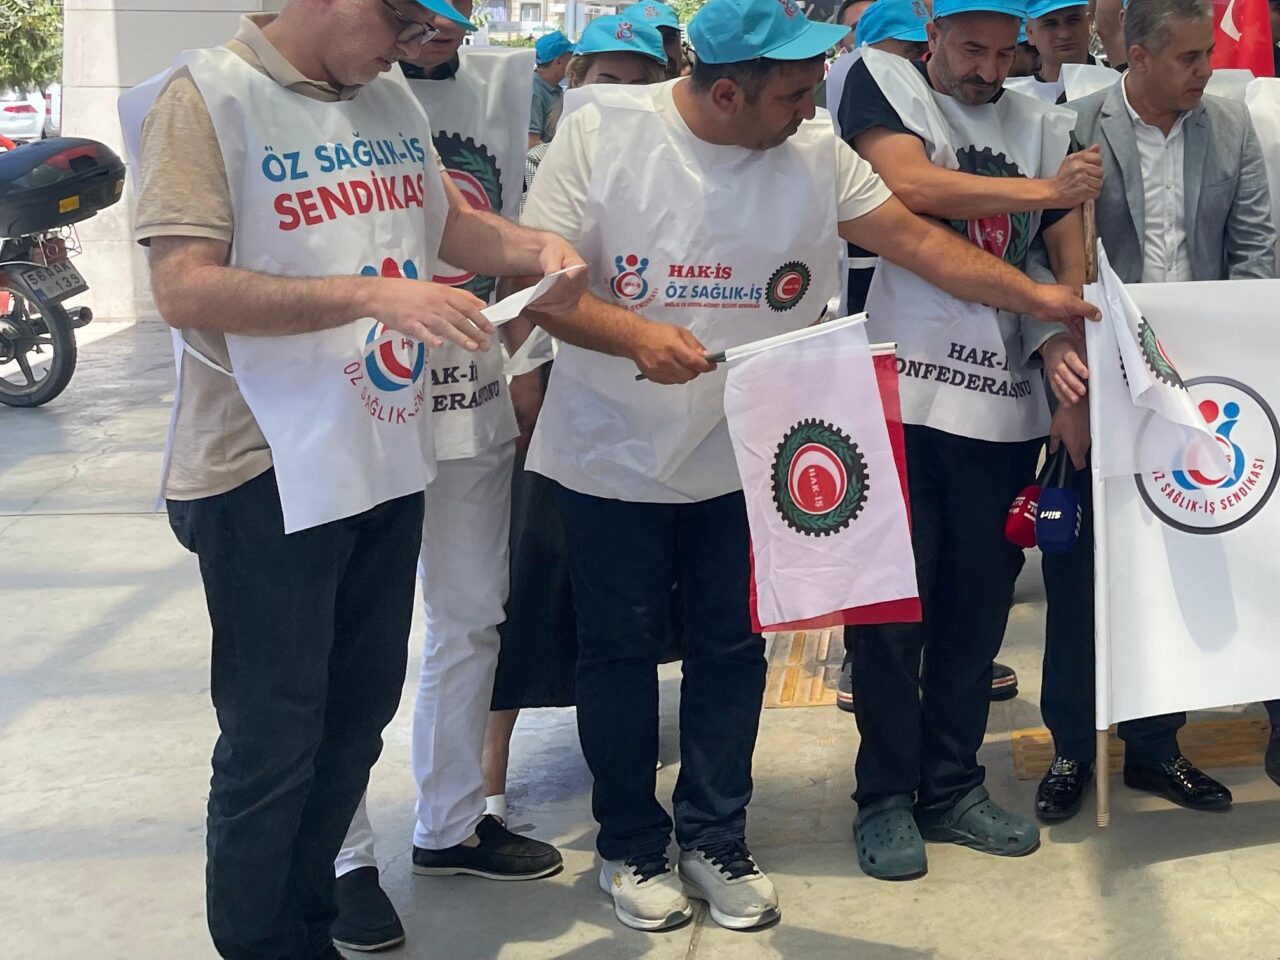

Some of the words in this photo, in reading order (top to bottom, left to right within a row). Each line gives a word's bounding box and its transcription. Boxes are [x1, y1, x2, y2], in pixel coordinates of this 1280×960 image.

[262, 145, 309, 183] ÖZ
[273, 170, 425, 232] SENDİKAS
[668, 262, 733, 280] HAK-İŞ
[665, 281, 688, 299] ÖZ
[690, 283, 763, 306] SAĞLIK-İŞ
[1160, 483, 1217, 515] SAĞLIK-İŞ
[1220, 458, 1265, 511] SENDİKASI
